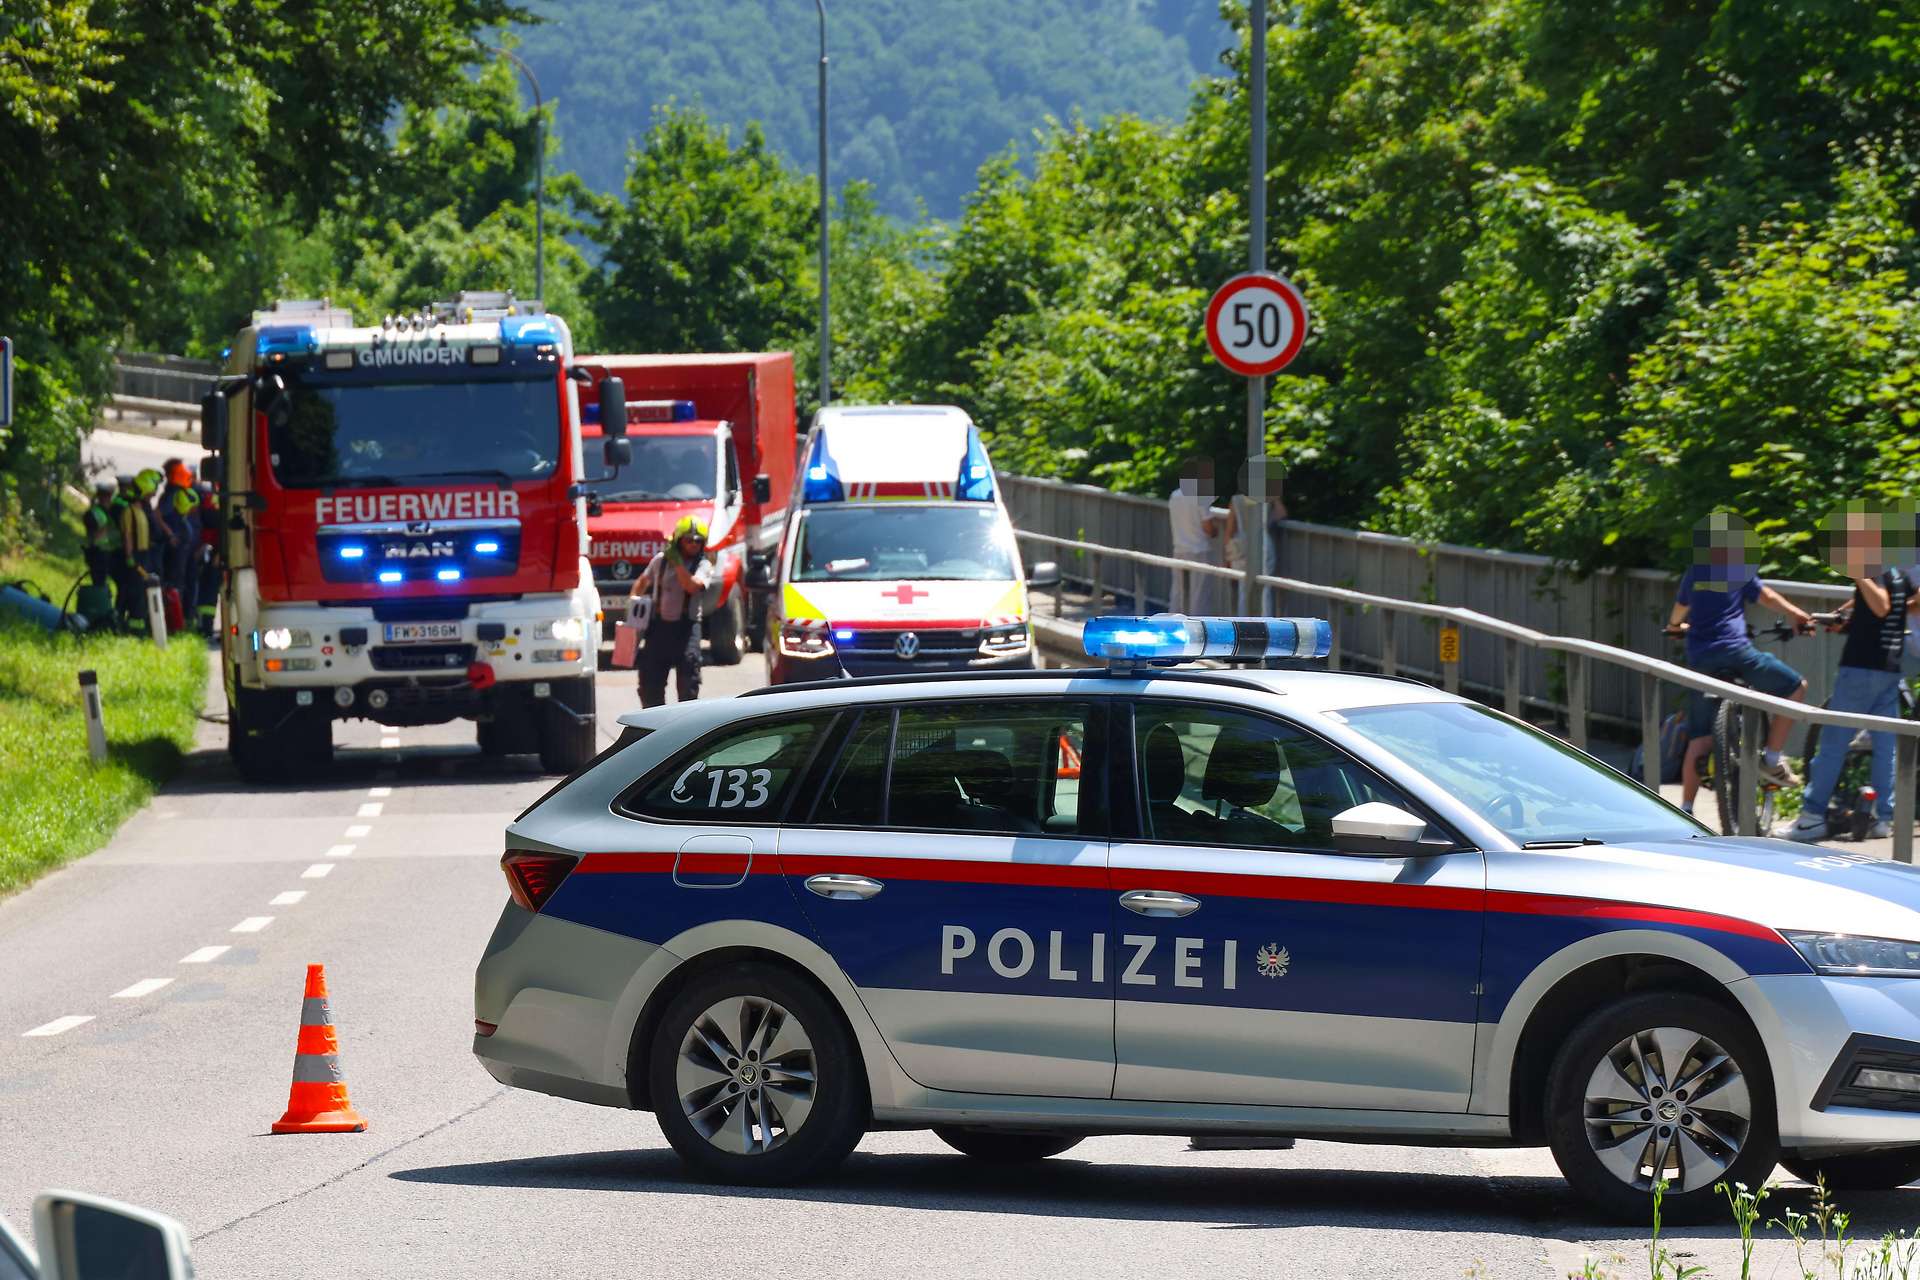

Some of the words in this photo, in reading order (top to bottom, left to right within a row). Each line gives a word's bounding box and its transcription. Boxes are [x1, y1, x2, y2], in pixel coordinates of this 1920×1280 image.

[1233, 303, 1280, 348] 50
[359, 347, 466, 366] GMUNDEN
[316, 490, 520, 523] FEUERWEHR
[384, 541, 454, 558] MAN
[589, 541, 670, 558] UERWEH
[707, 768, 772, 808] 133
[941, 924, 1238, 990] POLIZEI
